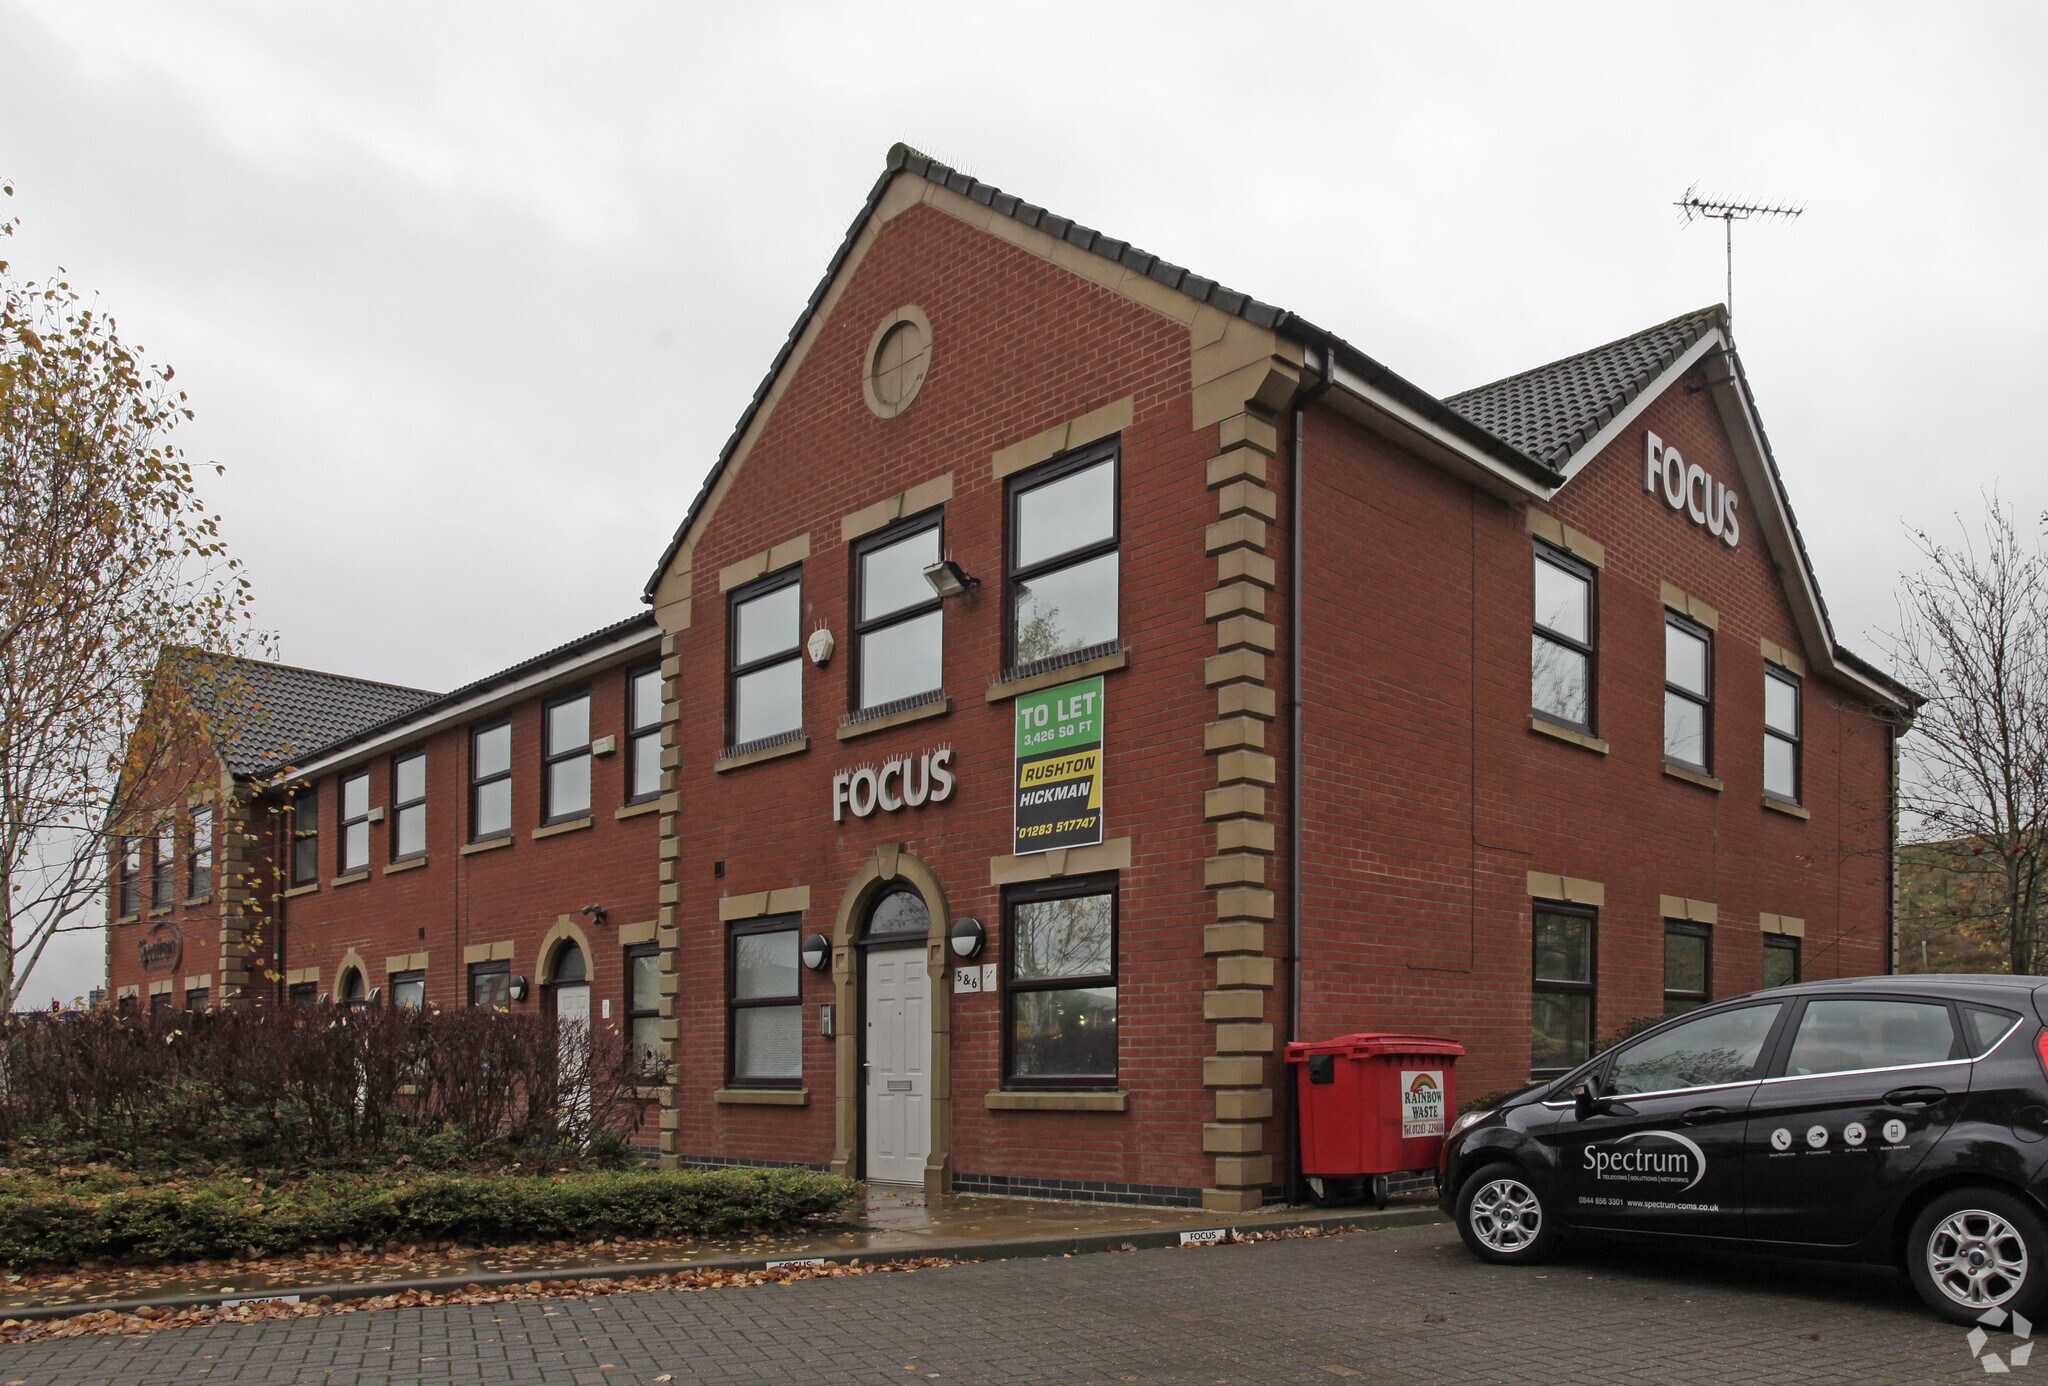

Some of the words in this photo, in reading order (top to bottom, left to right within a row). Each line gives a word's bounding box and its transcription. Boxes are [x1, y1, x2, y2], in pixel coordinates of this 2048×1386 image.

[1645, 430, 1740, 547] FOCUS
[1021, 704, 1049, 730] TO
[1057, 692, 1096, 722] LET
[1024, 729, 1054, 747] 3,426
[1058, 724, 1075, 739] SQ
[1078, 720, 1093, 734] FT
[1025, 756, 1096, 782] RUSHTON
[833, 749, 955, 821] FOCUS
[1019, 781, 1091, 807] HICKMAN
[1019, 823, 1053, 839] 01283
[1055, 816, 1097, 833] 517747
[957, 971, 962, 982] 5
[972, 978, 977, 988] 6
[1404, 1091, 1442, 1104] RAINBOW
[1412, 1106, 1438, 1118] WASTE
[1583, 1145, 1689, 1180] Spectrum
[1627, 1200, 1719, 1211] www.spectrum-coms.co.uk
[1190, 1232, 1216, 1240] FOCUS
